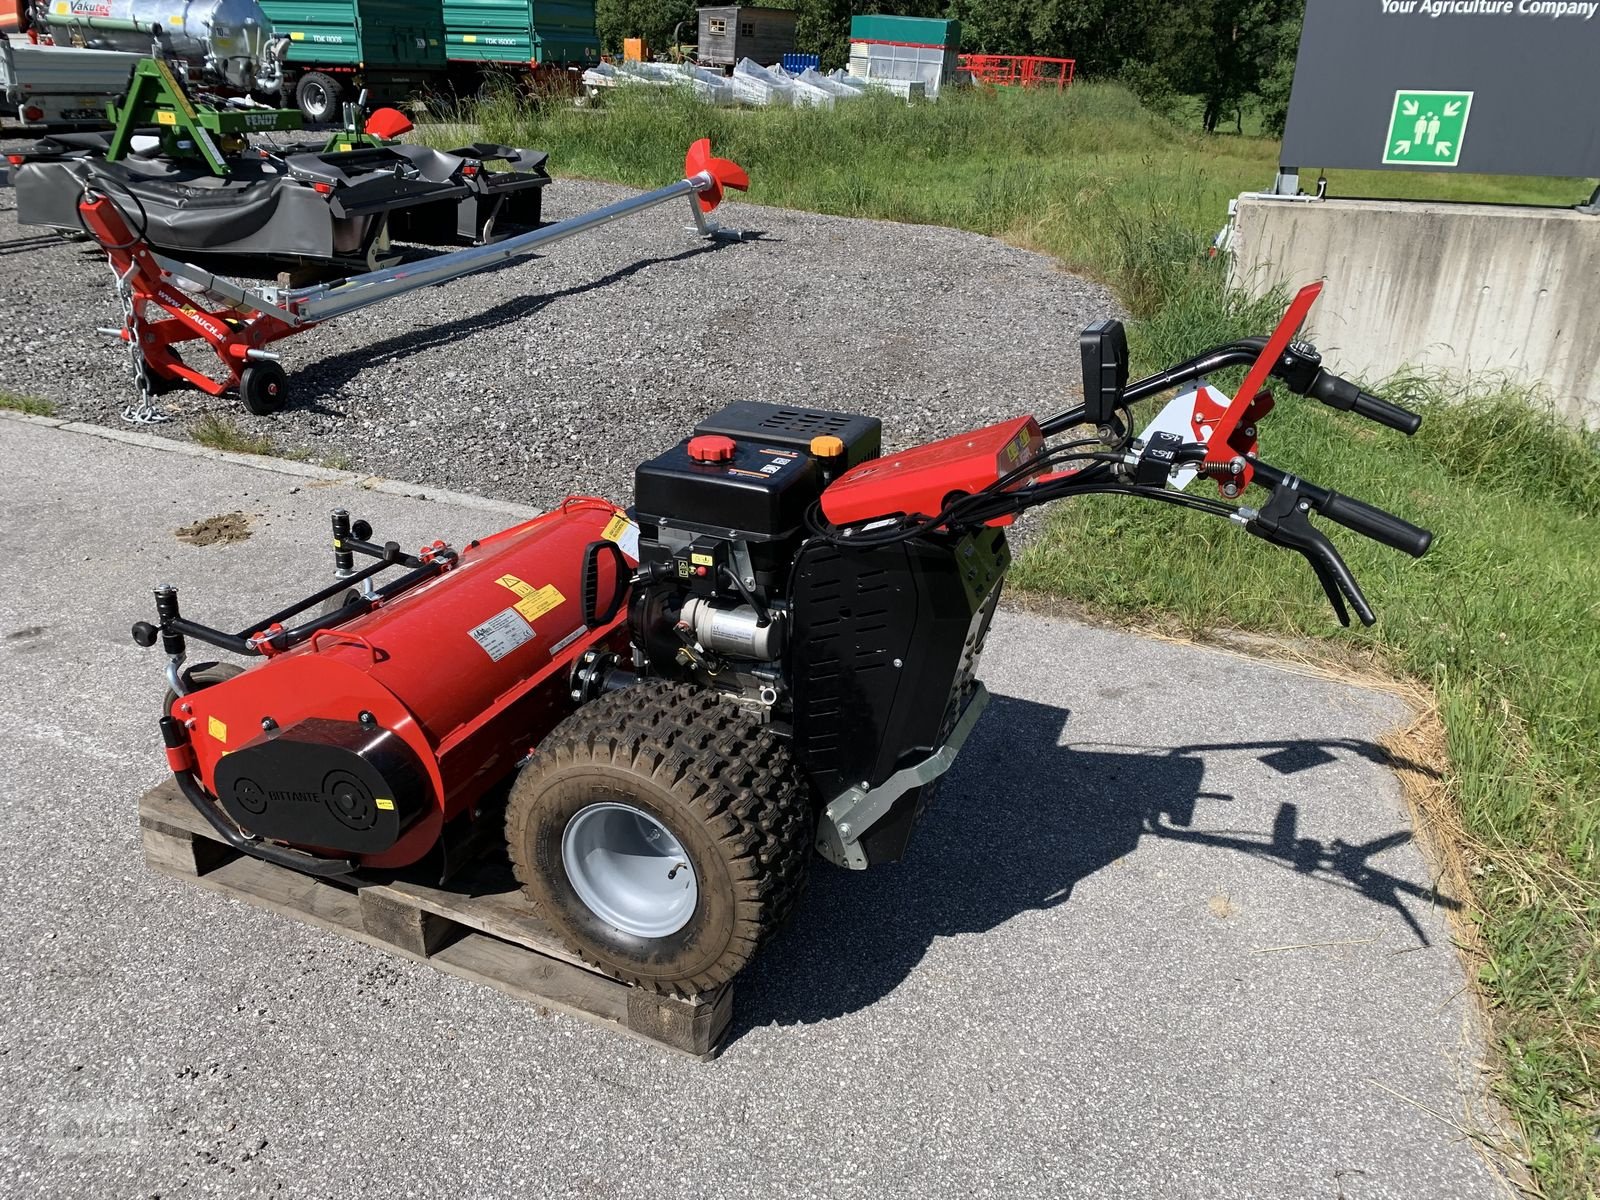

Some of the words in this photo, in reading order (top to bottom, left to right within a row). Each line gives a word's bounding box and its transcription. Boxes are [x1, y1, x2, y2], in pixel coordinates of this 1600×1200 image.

[70, 0, 111, 13] Vakutec
[1381, 0, 1416, 14] Your
[1419, 0, 1514, 18] Agriculture
[1518, 0, 1599, 19] Company
[244, 114, 279, 126] FENDT
